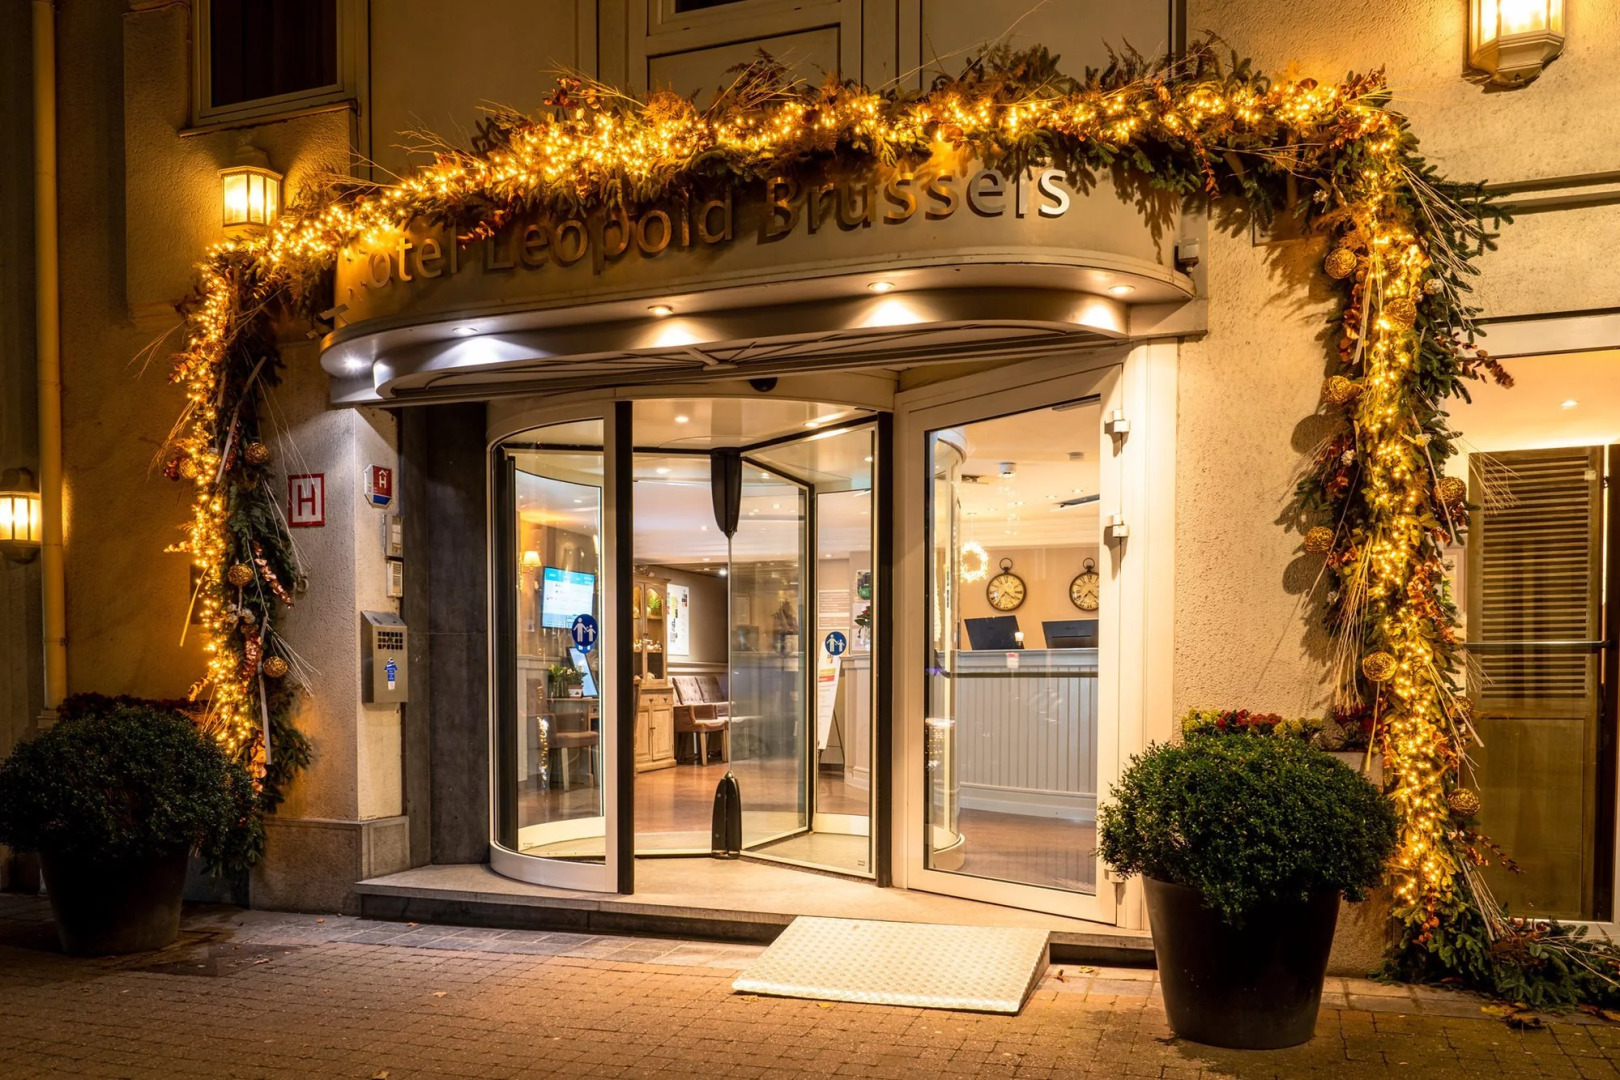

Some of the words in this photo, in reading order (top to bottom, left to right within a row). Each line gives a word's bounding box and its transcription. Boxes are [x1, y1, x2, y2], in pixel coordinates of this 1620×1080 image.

[487, 189, 733, 274] Leopold
[765, 157, 1071, 238] Brussels
[298, 483, 316, 516] H
